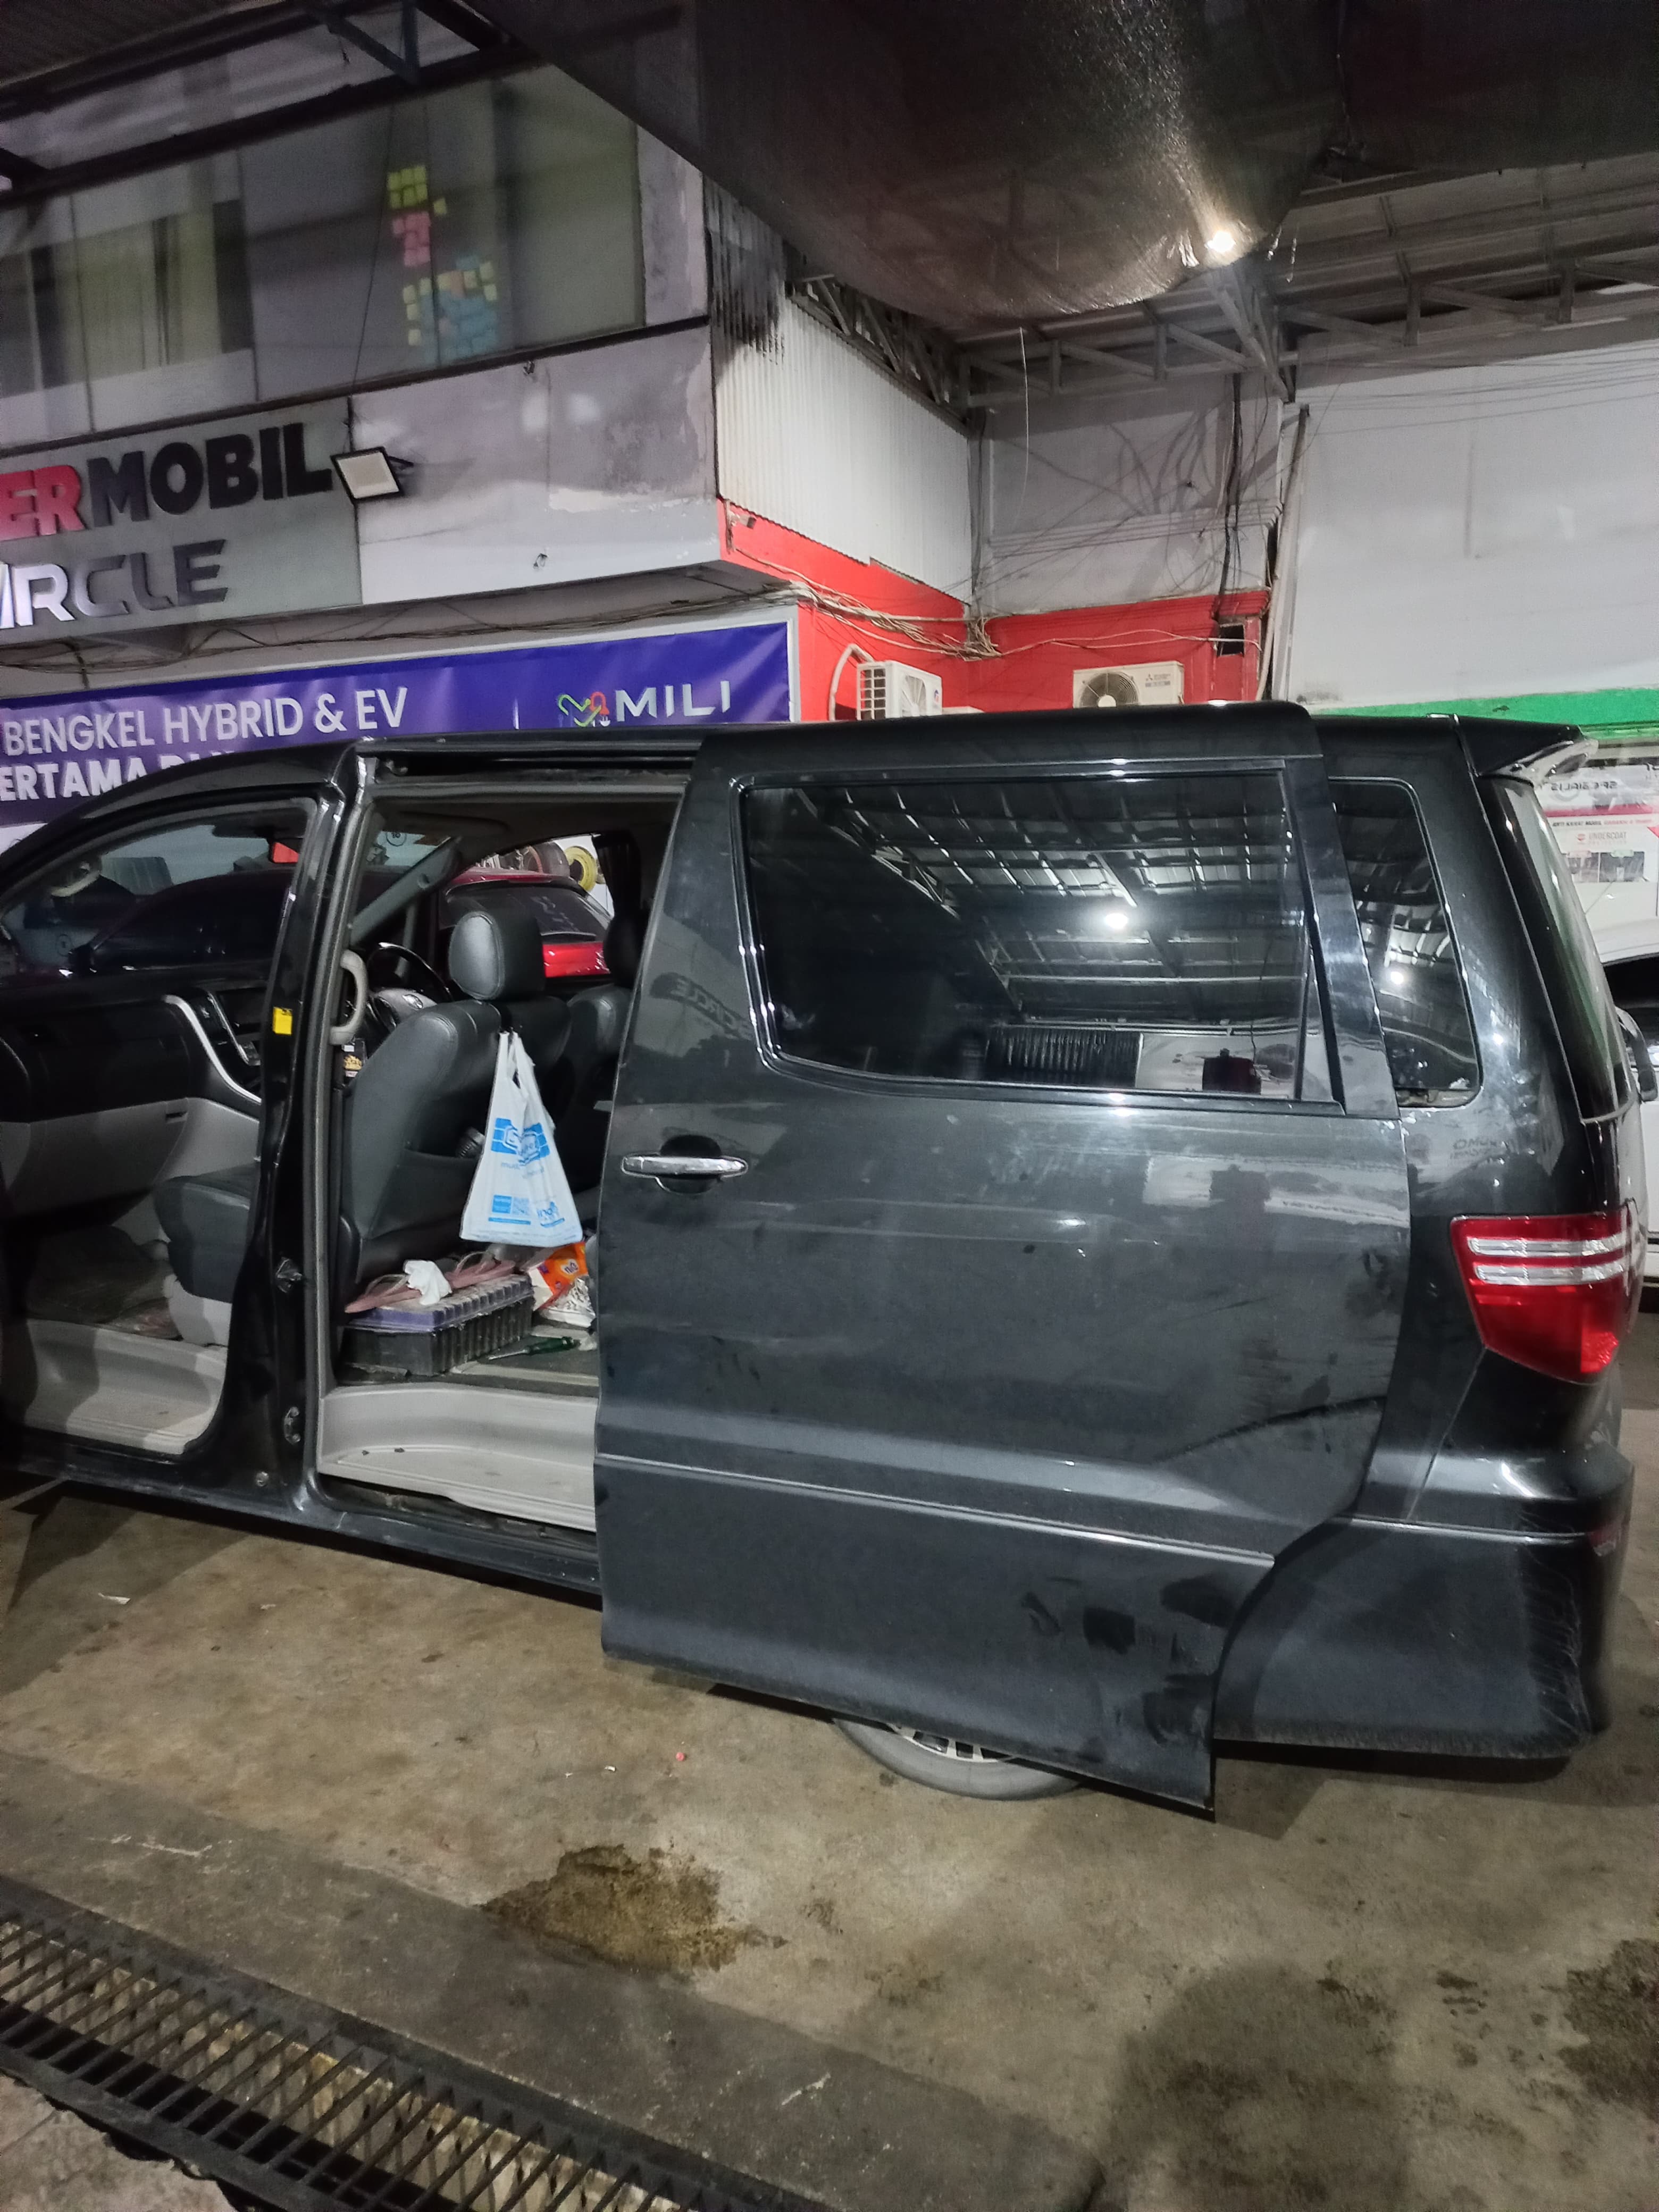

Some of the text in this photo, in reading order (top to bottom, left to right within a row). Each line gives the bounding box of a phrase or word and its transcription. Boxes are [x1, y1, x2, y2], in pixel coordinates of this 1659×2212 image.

[4, 687, 407, 756] BENGKEL HYBRID & EV
[615, 681, 731, 723] MILI
